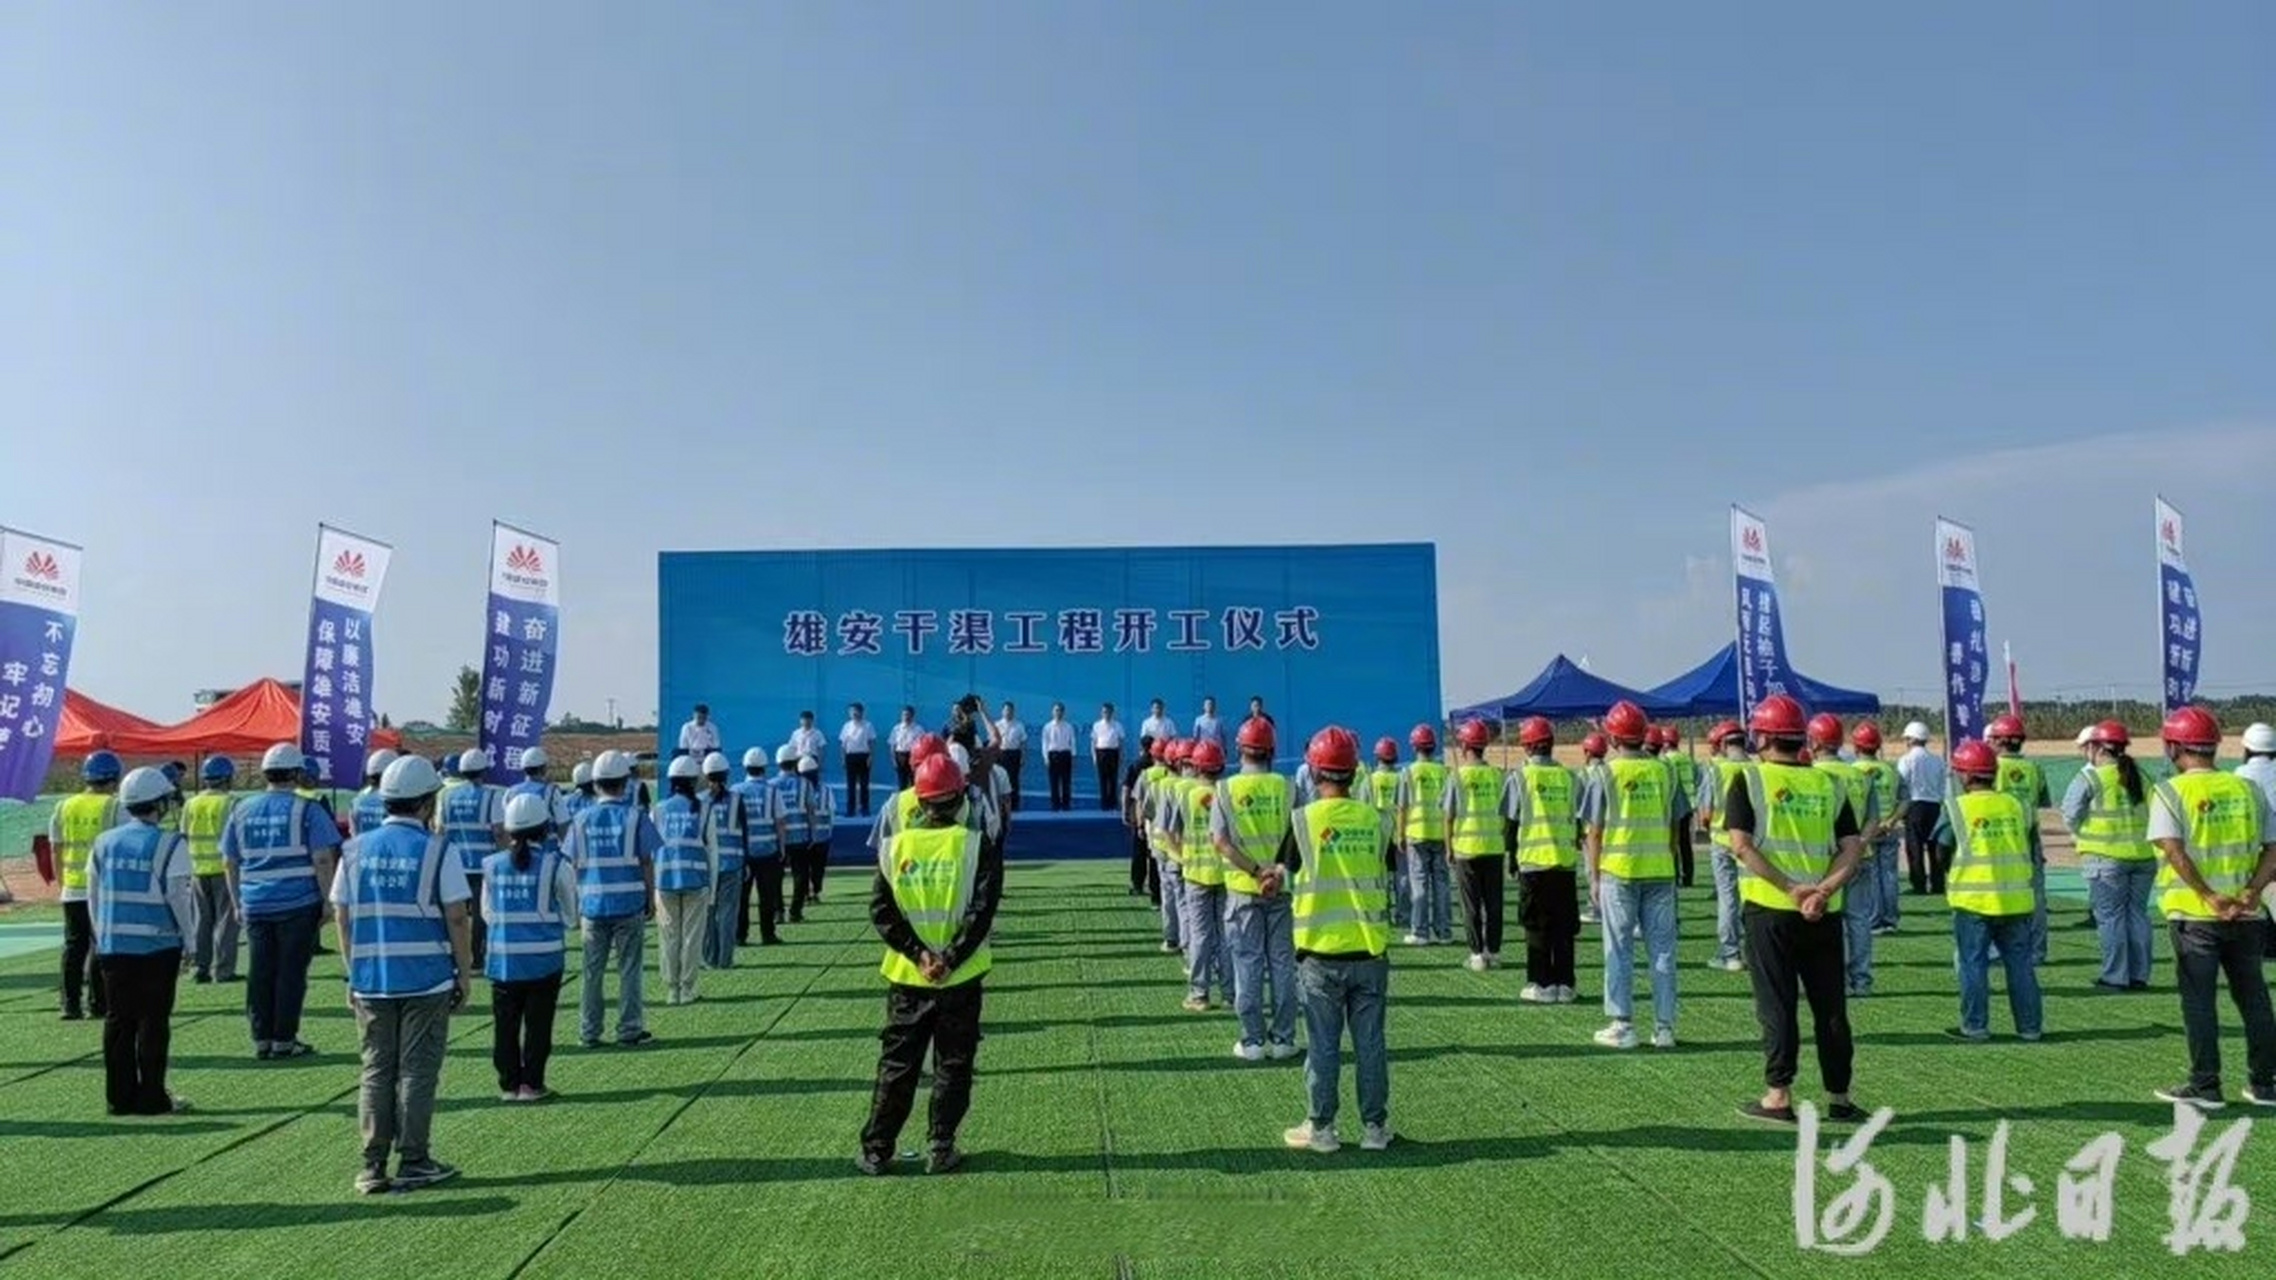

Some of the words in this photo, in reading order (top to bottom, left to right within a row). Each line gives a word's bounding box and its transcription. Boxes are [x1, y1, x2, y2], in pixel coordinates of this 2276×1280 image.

[21, 620, 64, 738] 不忘初心
[783, 606, 1321, 656] 雄安干渠工程开工仪式
[502, 616, 547, 770] 奋进新征程
